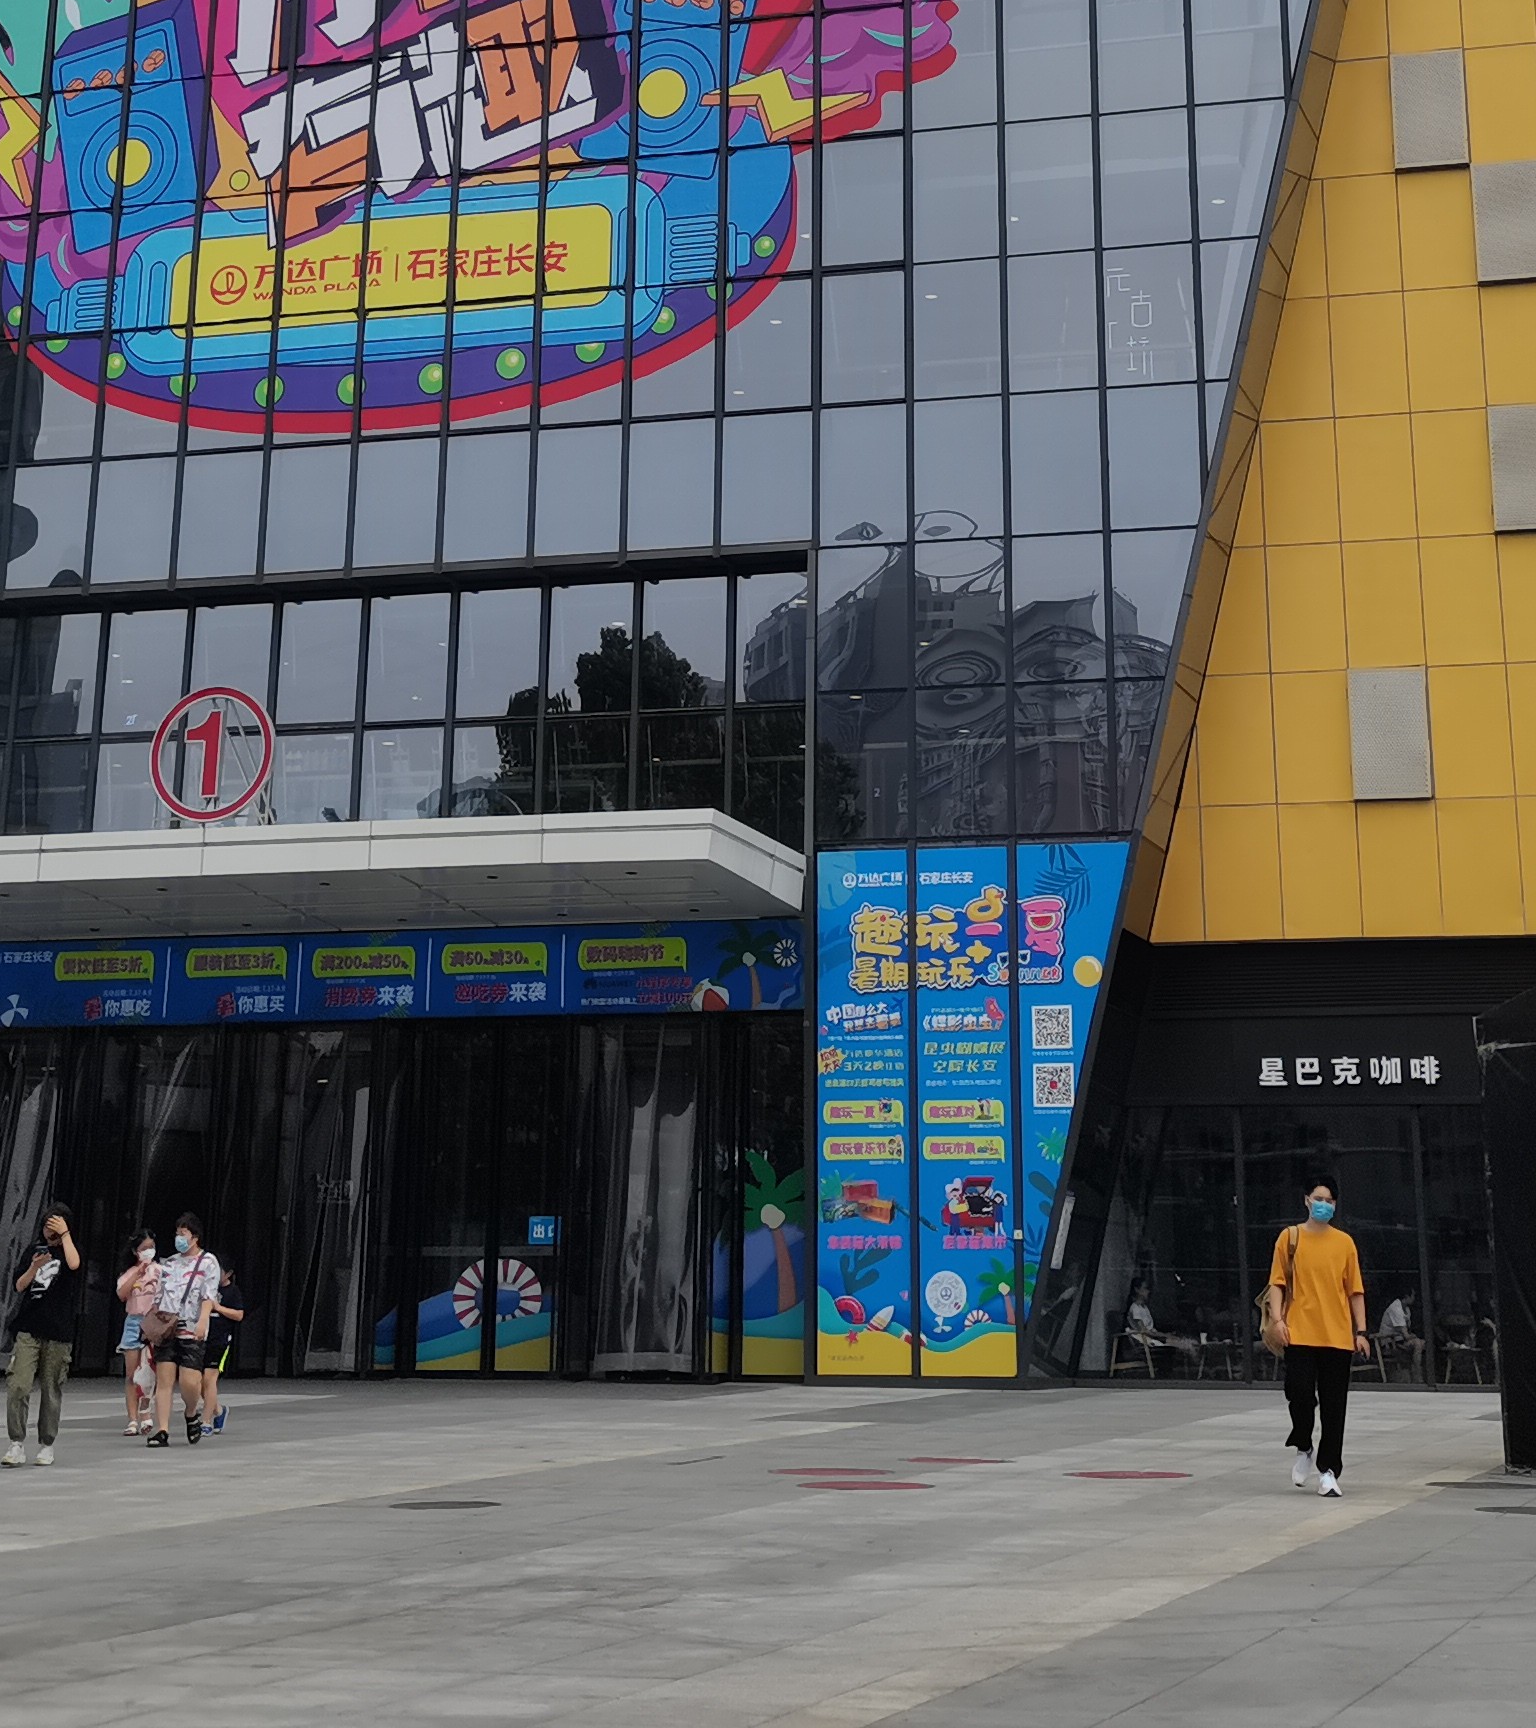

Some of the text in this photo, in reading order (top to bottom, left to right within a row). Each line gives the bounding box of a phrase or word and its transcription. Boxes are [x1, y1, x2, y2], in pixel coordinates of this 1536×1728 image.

[253, 241, 568, 290] 万达广场 石家庄长安
[1258, 1055, 1442, 1087] 星巴克咖啡
